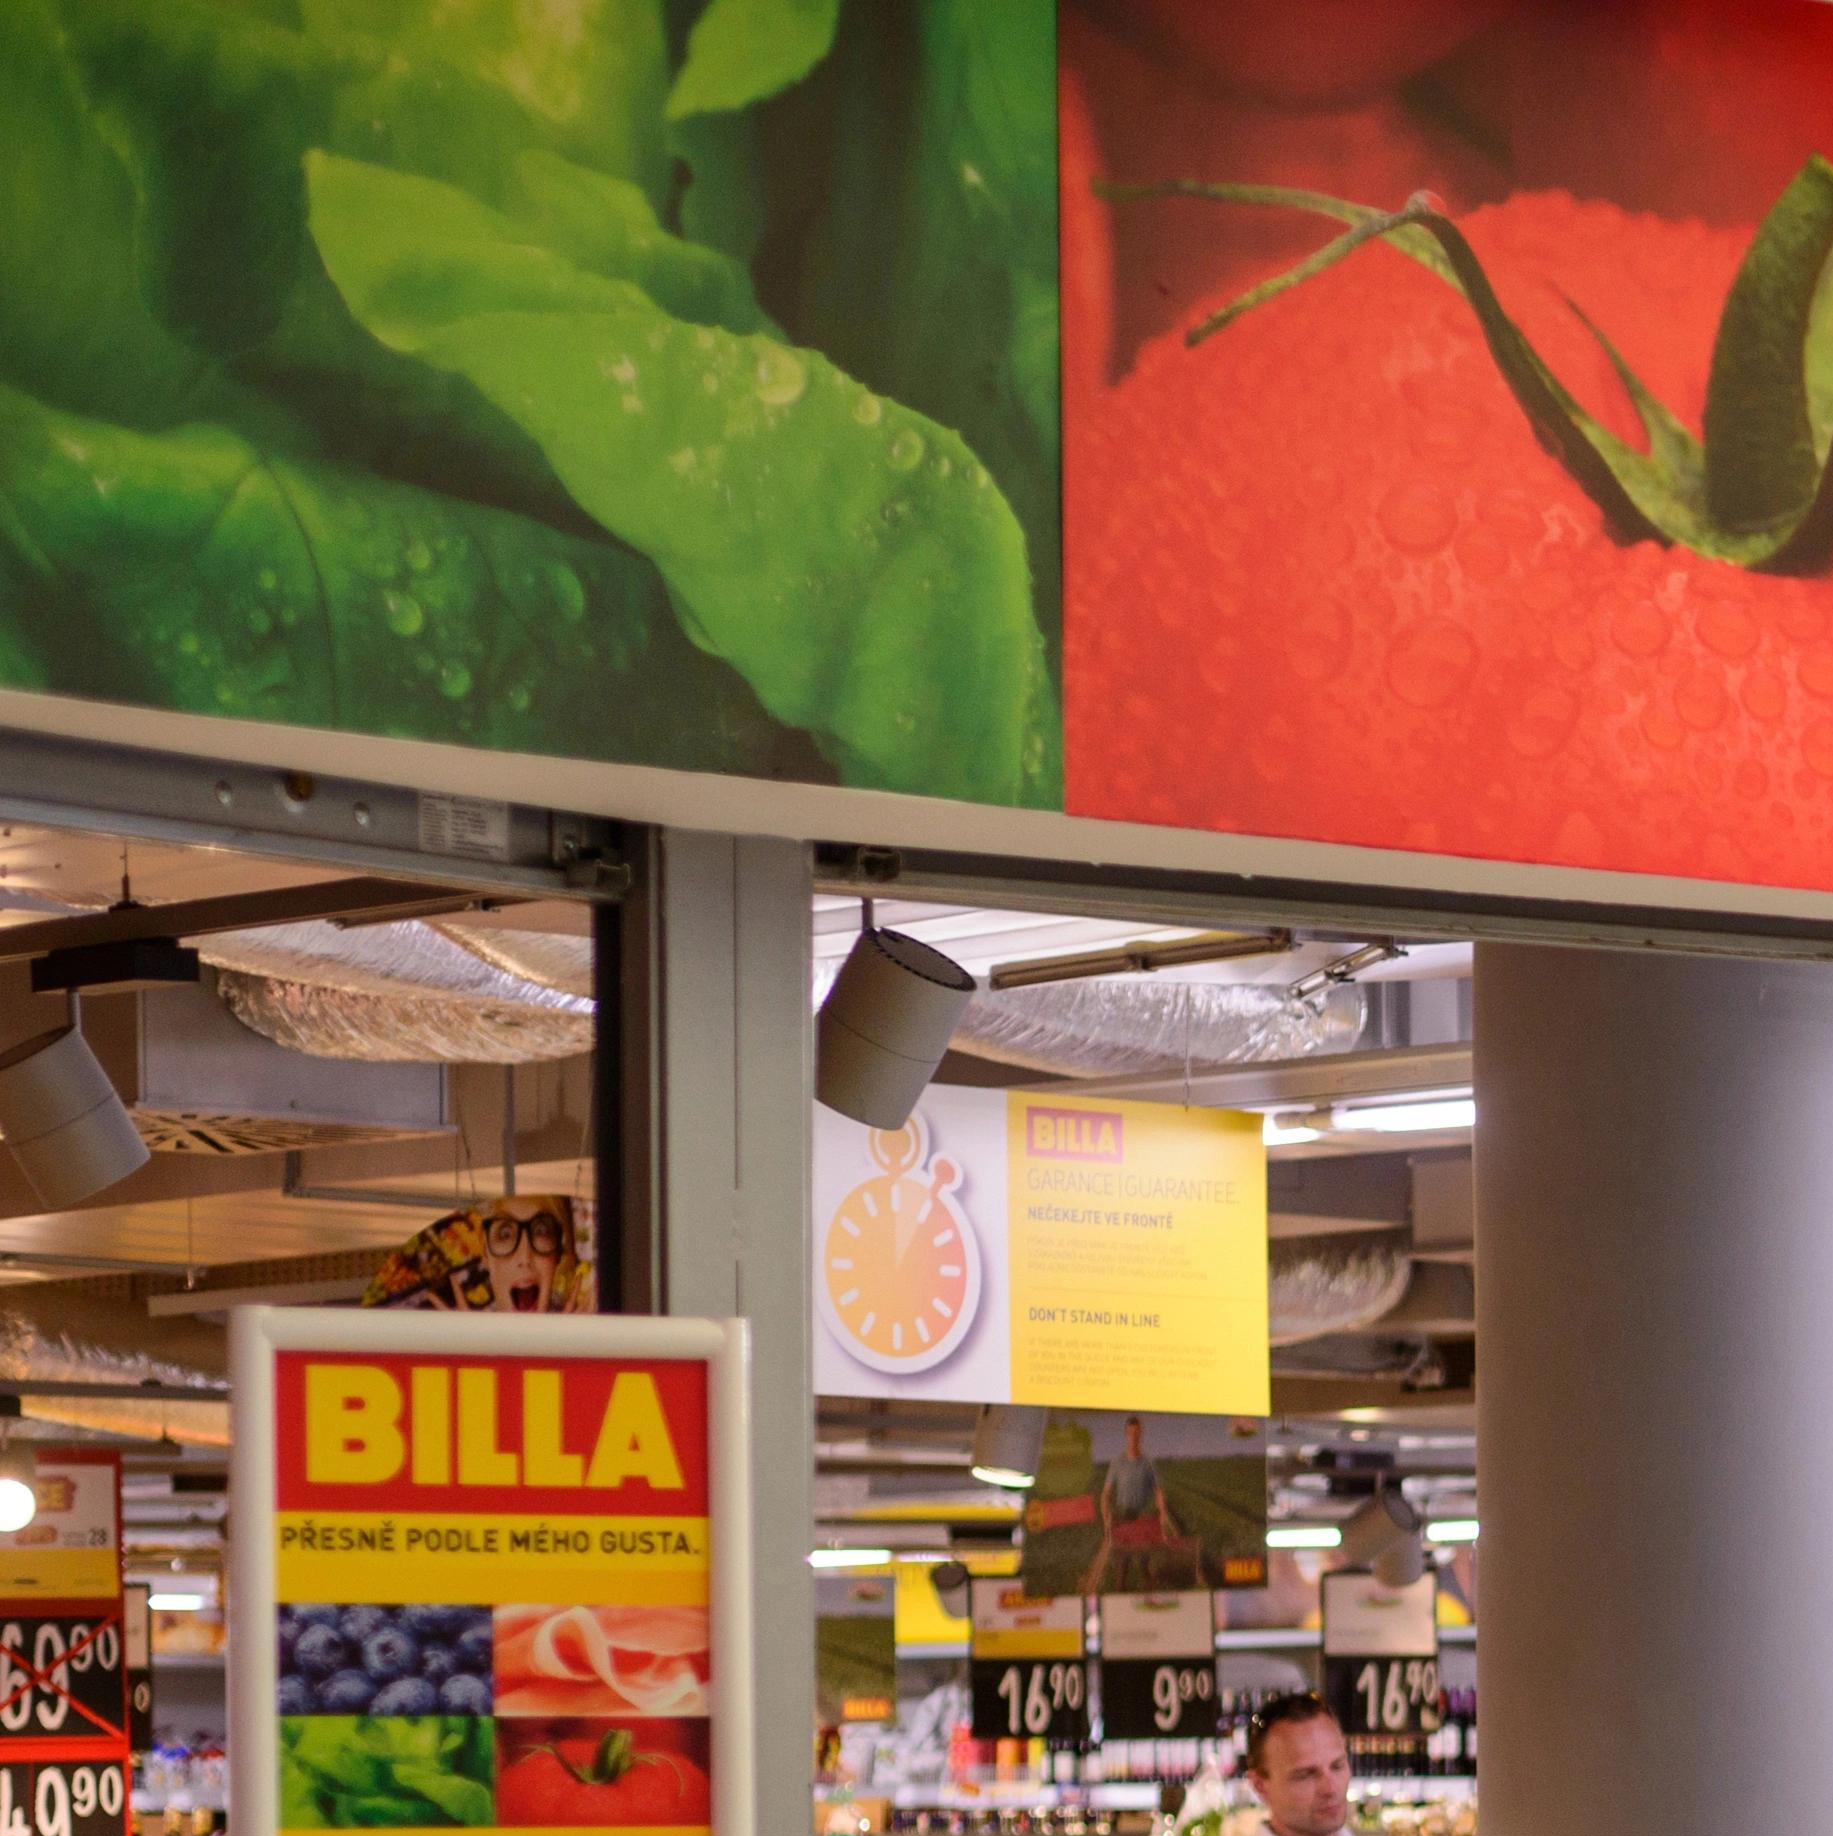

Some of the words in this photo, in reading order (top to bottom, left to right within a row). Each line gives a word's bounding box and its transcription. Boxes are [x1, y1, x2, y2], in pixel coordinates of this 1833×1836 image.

[1033, 1116, 1117, 1155] BILLA
[1070, 1310, 1112, 1325] STAND
[1115, 1314, 1129, 1327] IN
[1131, 1314, 1161, 1328] LINE
[305, 1364, 685, 1490] BILLA
[280, 1520, 396, 1551] PŘESNĚ
[406, 1527, 499, 1554] PODLE
[509, 1523, 592, 1556] MÉHO
[600, 1528, 701, 1557] GUSTA.
